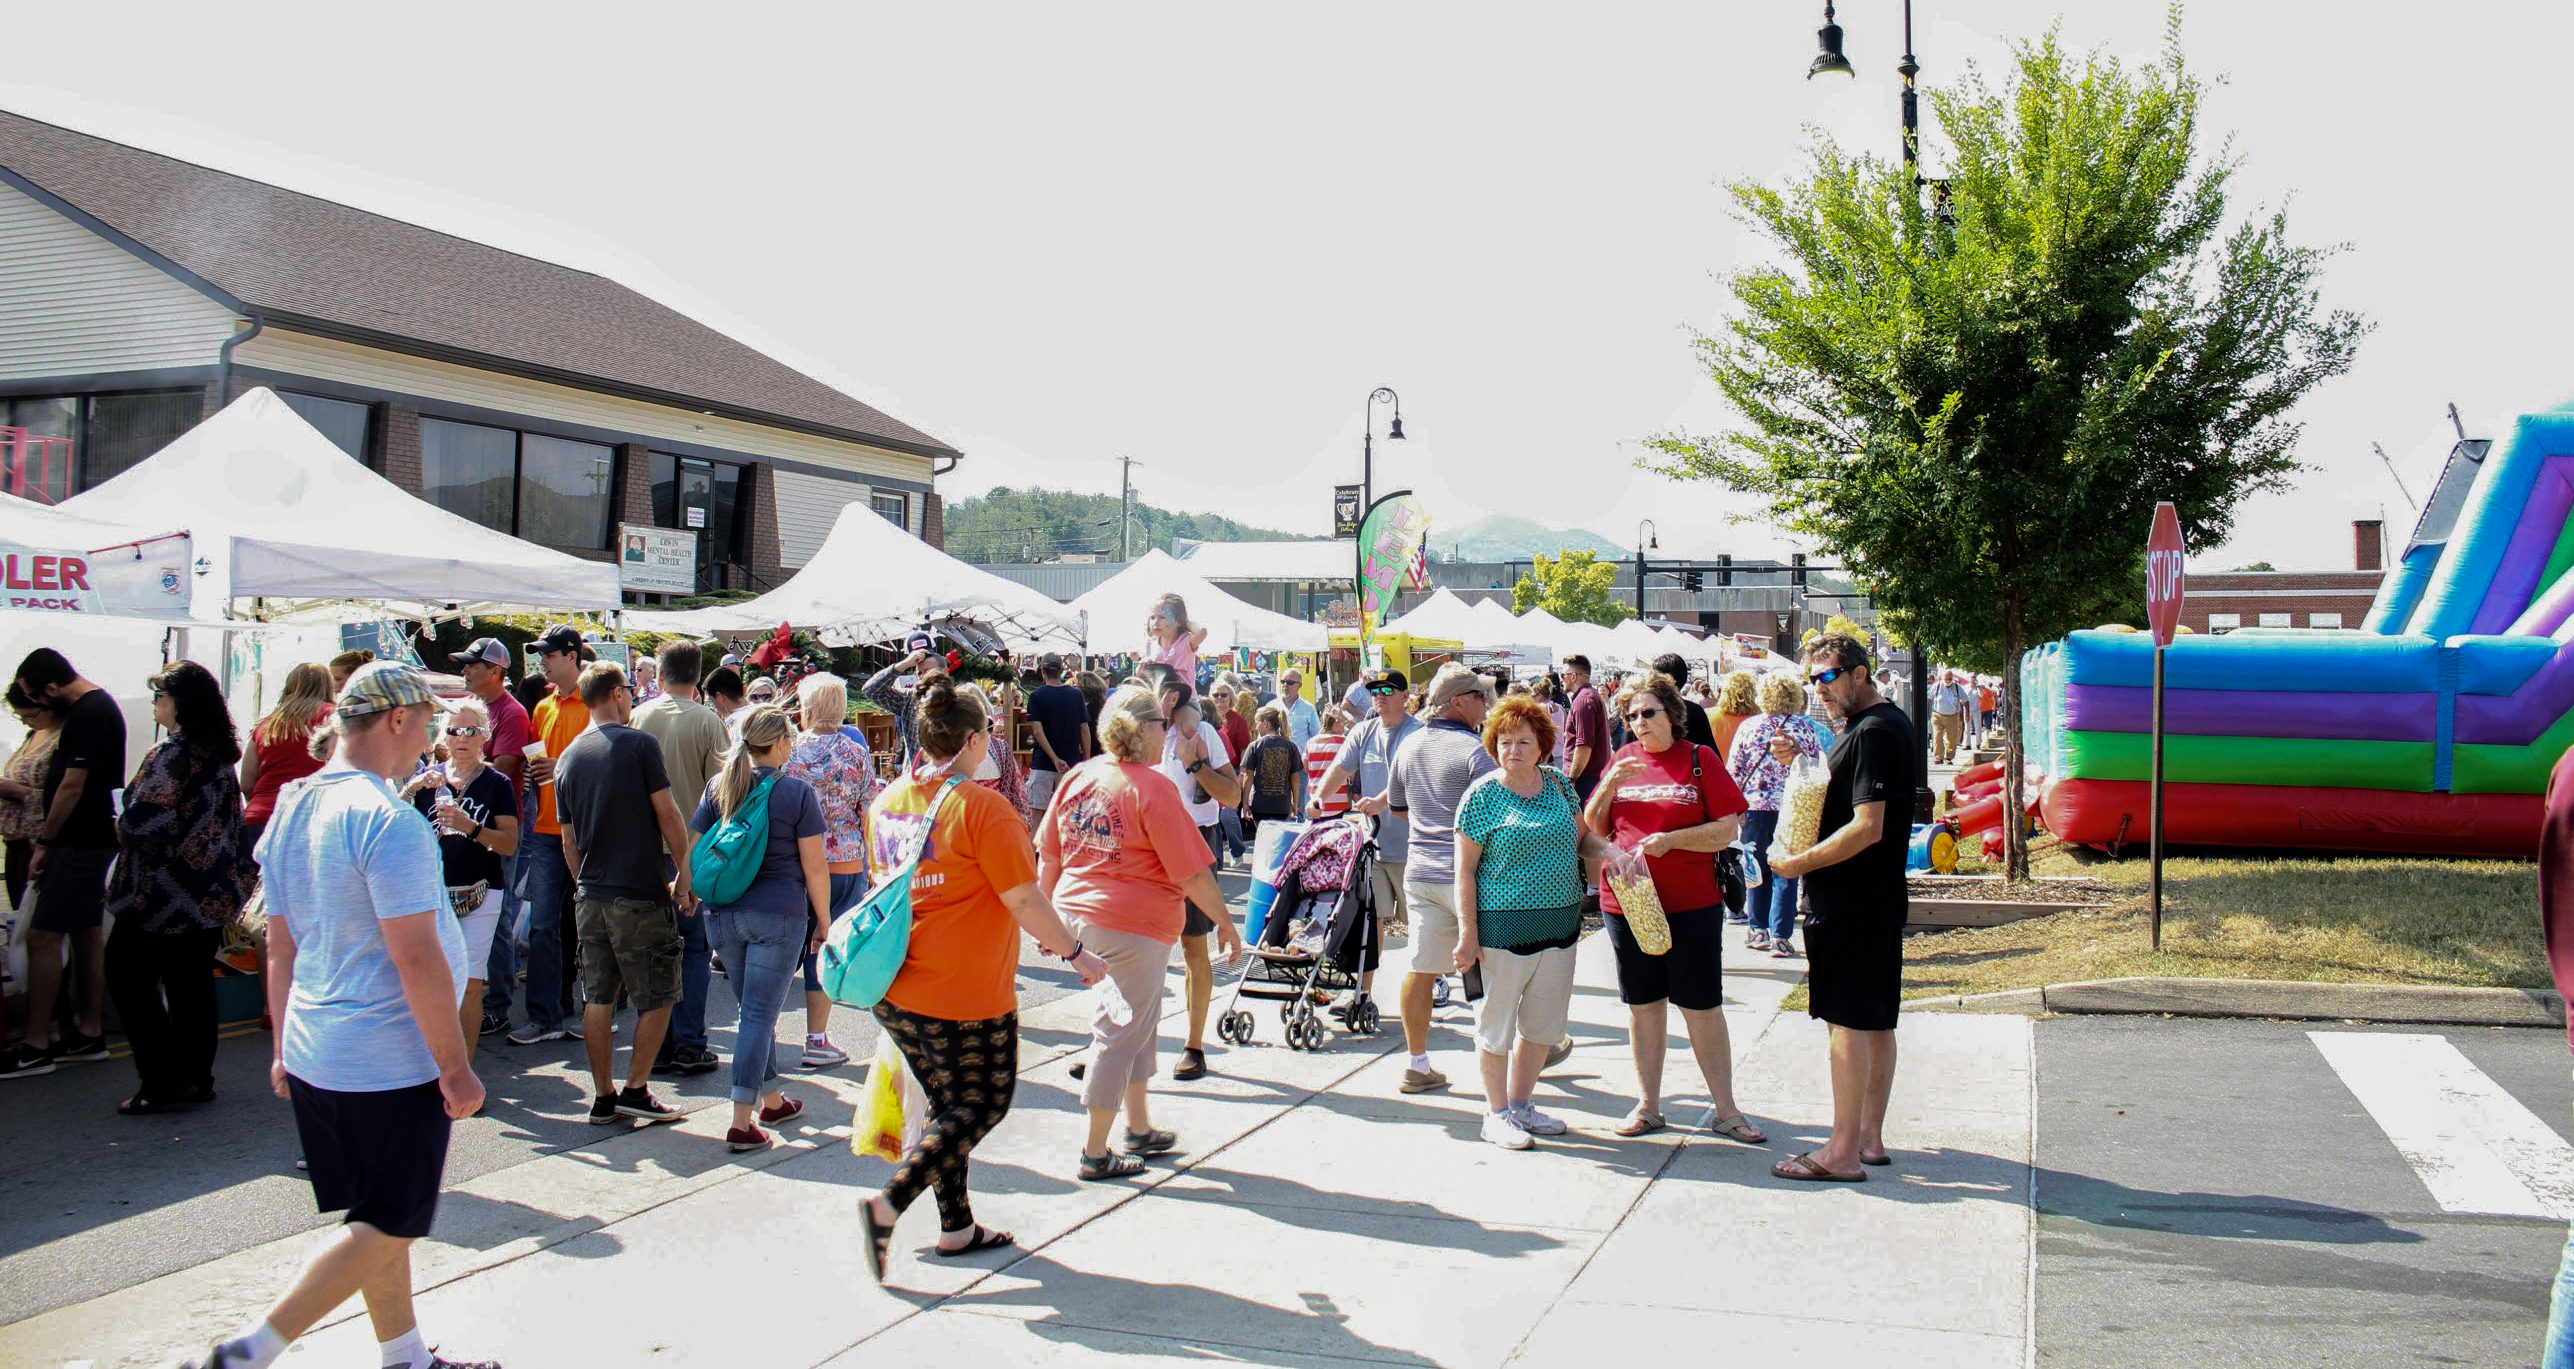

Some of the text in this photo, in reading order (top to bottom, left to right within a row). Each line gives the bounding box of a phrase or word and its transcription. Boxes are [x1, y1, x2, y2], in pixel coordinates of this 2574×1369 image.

[660, 538, 678, 547] ERWIN
[647, 546, 692, 558] MENTAL HEALTH
[658, 555, 680, 566] CENTER
[2150, 551, 2181, 602] STOP
[10, 598, 80, 611] PACK
[1110, 808, 1124, 830] TIME
